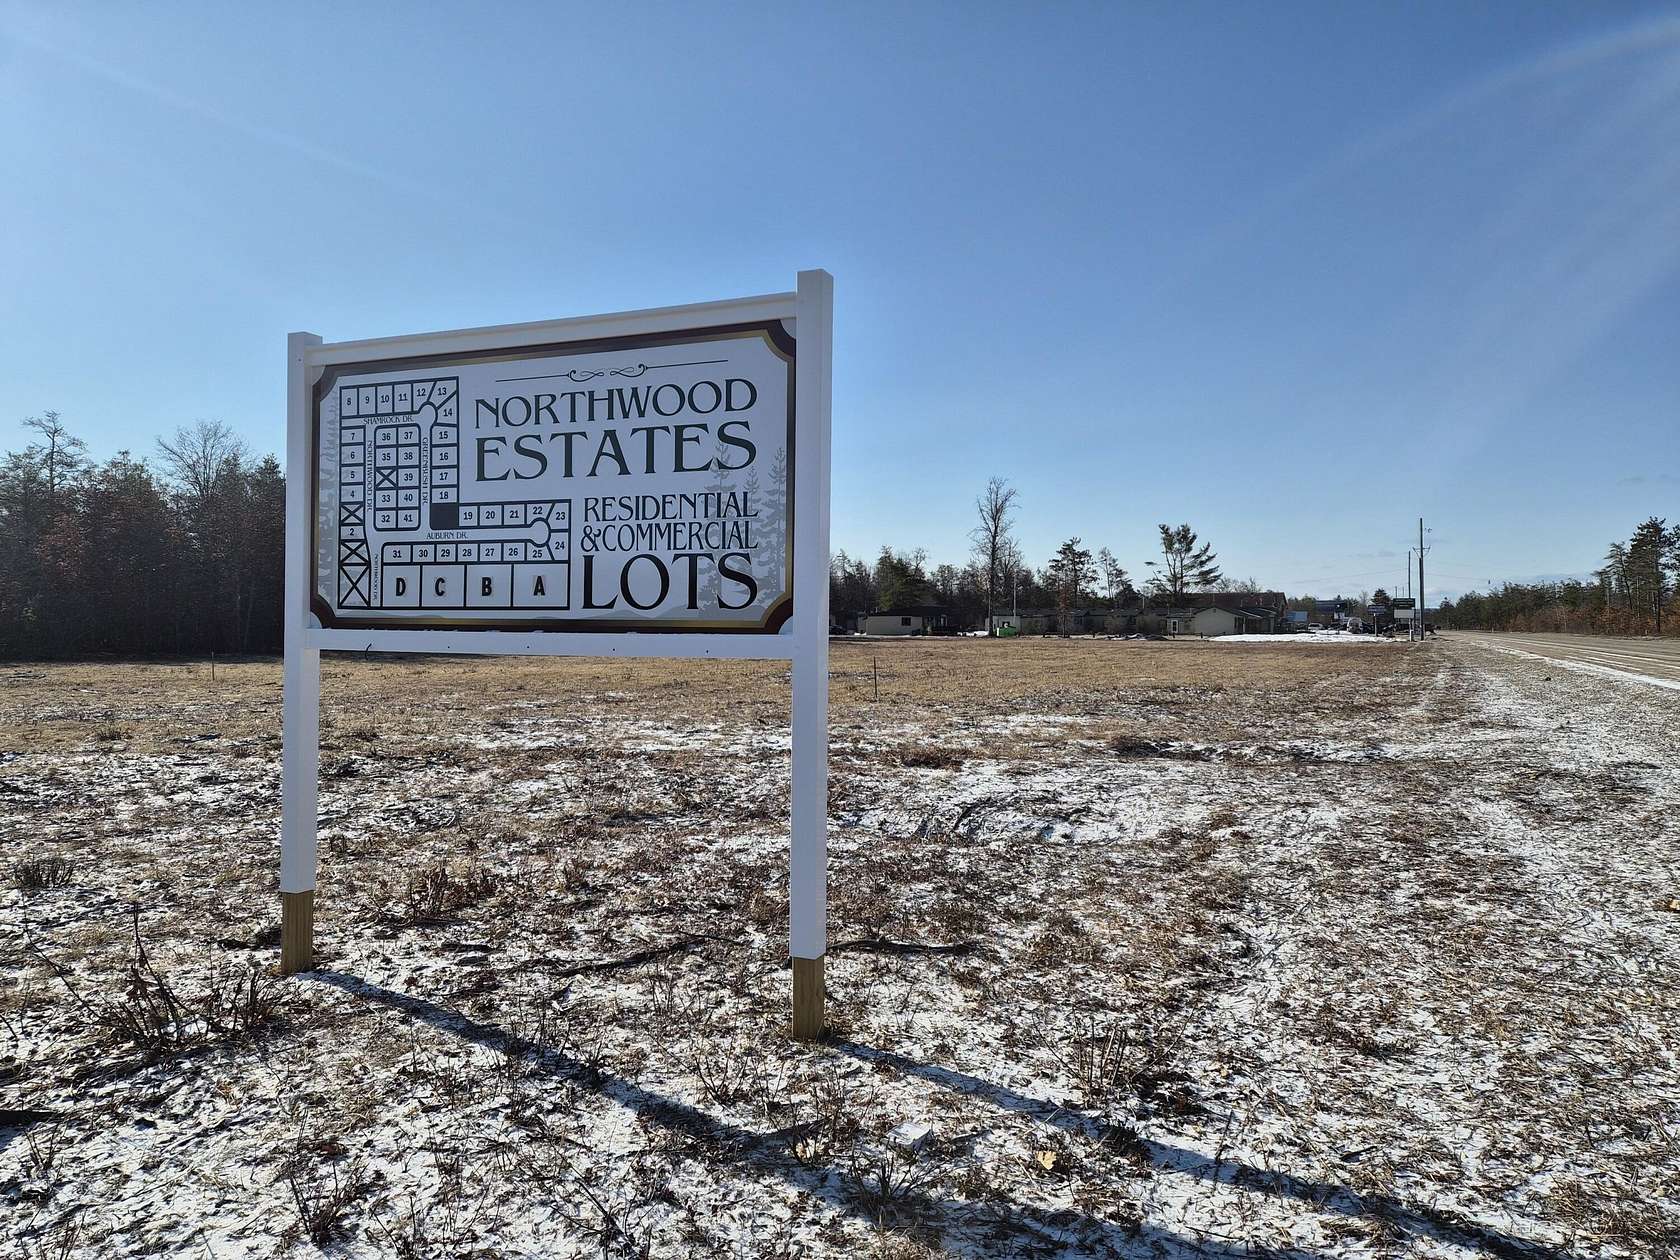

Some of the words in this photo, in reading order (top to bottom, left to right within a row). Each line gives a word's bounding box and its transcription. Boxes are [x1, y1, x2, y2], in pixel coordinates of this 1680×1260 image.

[416, 388, 426, 397] 12
[438, 387, 447, 396] 13
[346, 397, 352, 406] 8
[365, 395, 370, 404] 9
[381, 394, 390, 403] 10
[399, 392, 408, 402] 11
[475, 378, 757, 429] NORTHWOOD
[443, 408, 453, 417] 14
[351, 432, 355, 441] 7
[381, 432, 391, 441] 36
[404, 431, 413, 440] 37
[439, 431, 449, 440] 15
[350, 451, 355, 460] 6
[475, 420, 757, 482] ESTATES
[381, 452, 391, 461] 35
[403, 452, 413, 461] 38
[439, 452, 449, 461] 16
[350, 471, 355, 479] 5
[403, 473, 413, 482] 39
[439, 472, 449, 481] 17
[350, 490, 355, 499] 4
[381, 494, 391, 503] 33
[403, 493, 413, 502] 40
[439, 491, 449, 500] 18
[532, 506, 543, 515] 22
[583, 491, 759, 523] RESIDENTIAL
[381, 514, 391, 523] 32
[403, 514, 413, 523] 41
[463, 511, 473, 521] 19
[485, 510, 495, 520] 20
[509, 510, 519, 519] 21
[555, 511, 566, 521] 23
[349, 527, 355, 536] 2
[554, 541, 565, 550] 24
[392, 550, 402, 559] 31
[418, 549, 428, 558] 30
[440, 549, 450, 558] 29
[462, 548, 472, 557] 28
[485, 547, 495, 557] 27
[508, 547, 519, 556] 26
[532, 549, 543, 559] 25
[533, 575, 546, 596] A
[581, 552, 759, 610] LOTS
[395, 577, 406, 597] D
[434, 577, 446, 597] C
[481, 576, 492, 597] B
